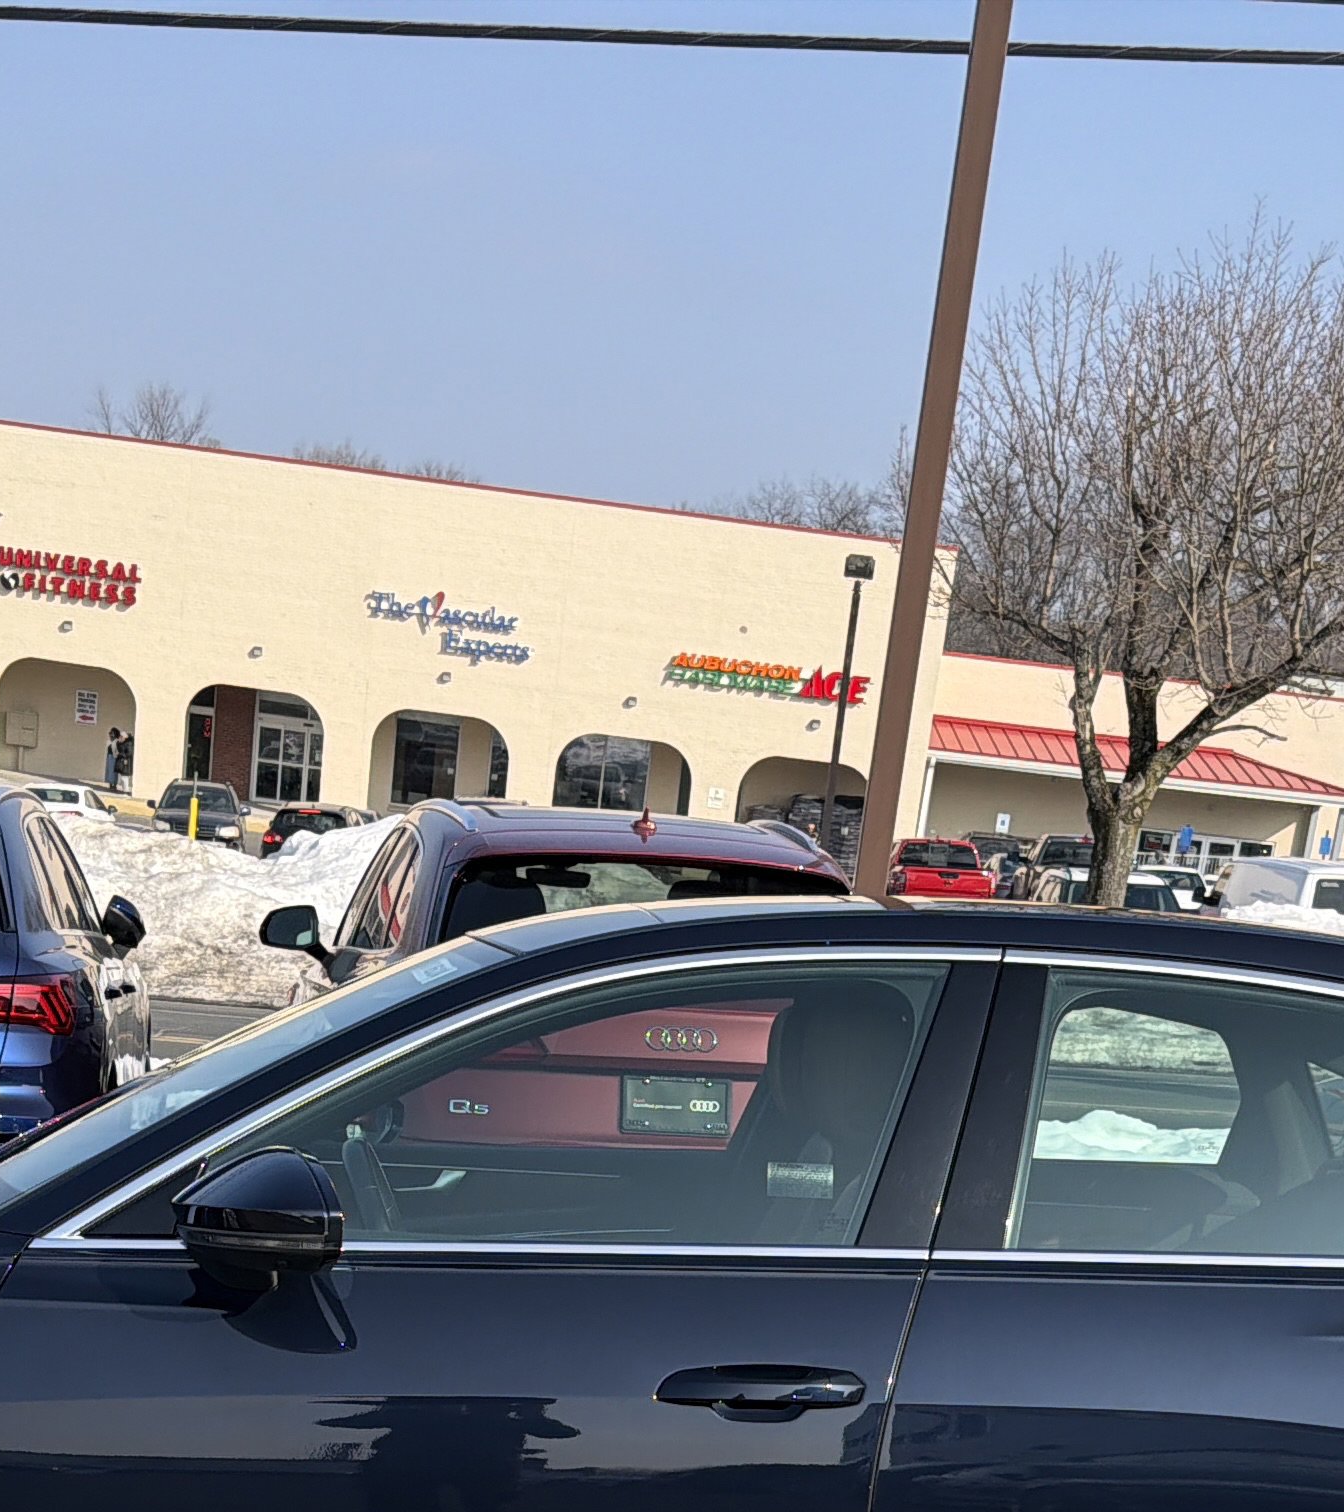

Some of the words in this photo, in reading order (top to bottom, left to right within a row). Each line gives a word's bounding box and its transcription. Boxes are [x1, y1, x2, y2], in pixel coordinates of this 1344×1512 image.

[22, 572, 137, 606] FITNESS
[364, 589, 417, 616] The
[416, 590, 519, 632] Vascular
[445, 628, 531, 664] Experts
[668, 667, 797, 695] HARDWARE
[671, 651, 803, 682] AUBUCHON
[799, 663, 873, 705] ACE
[448, 1098, 489, 1115] Q5
